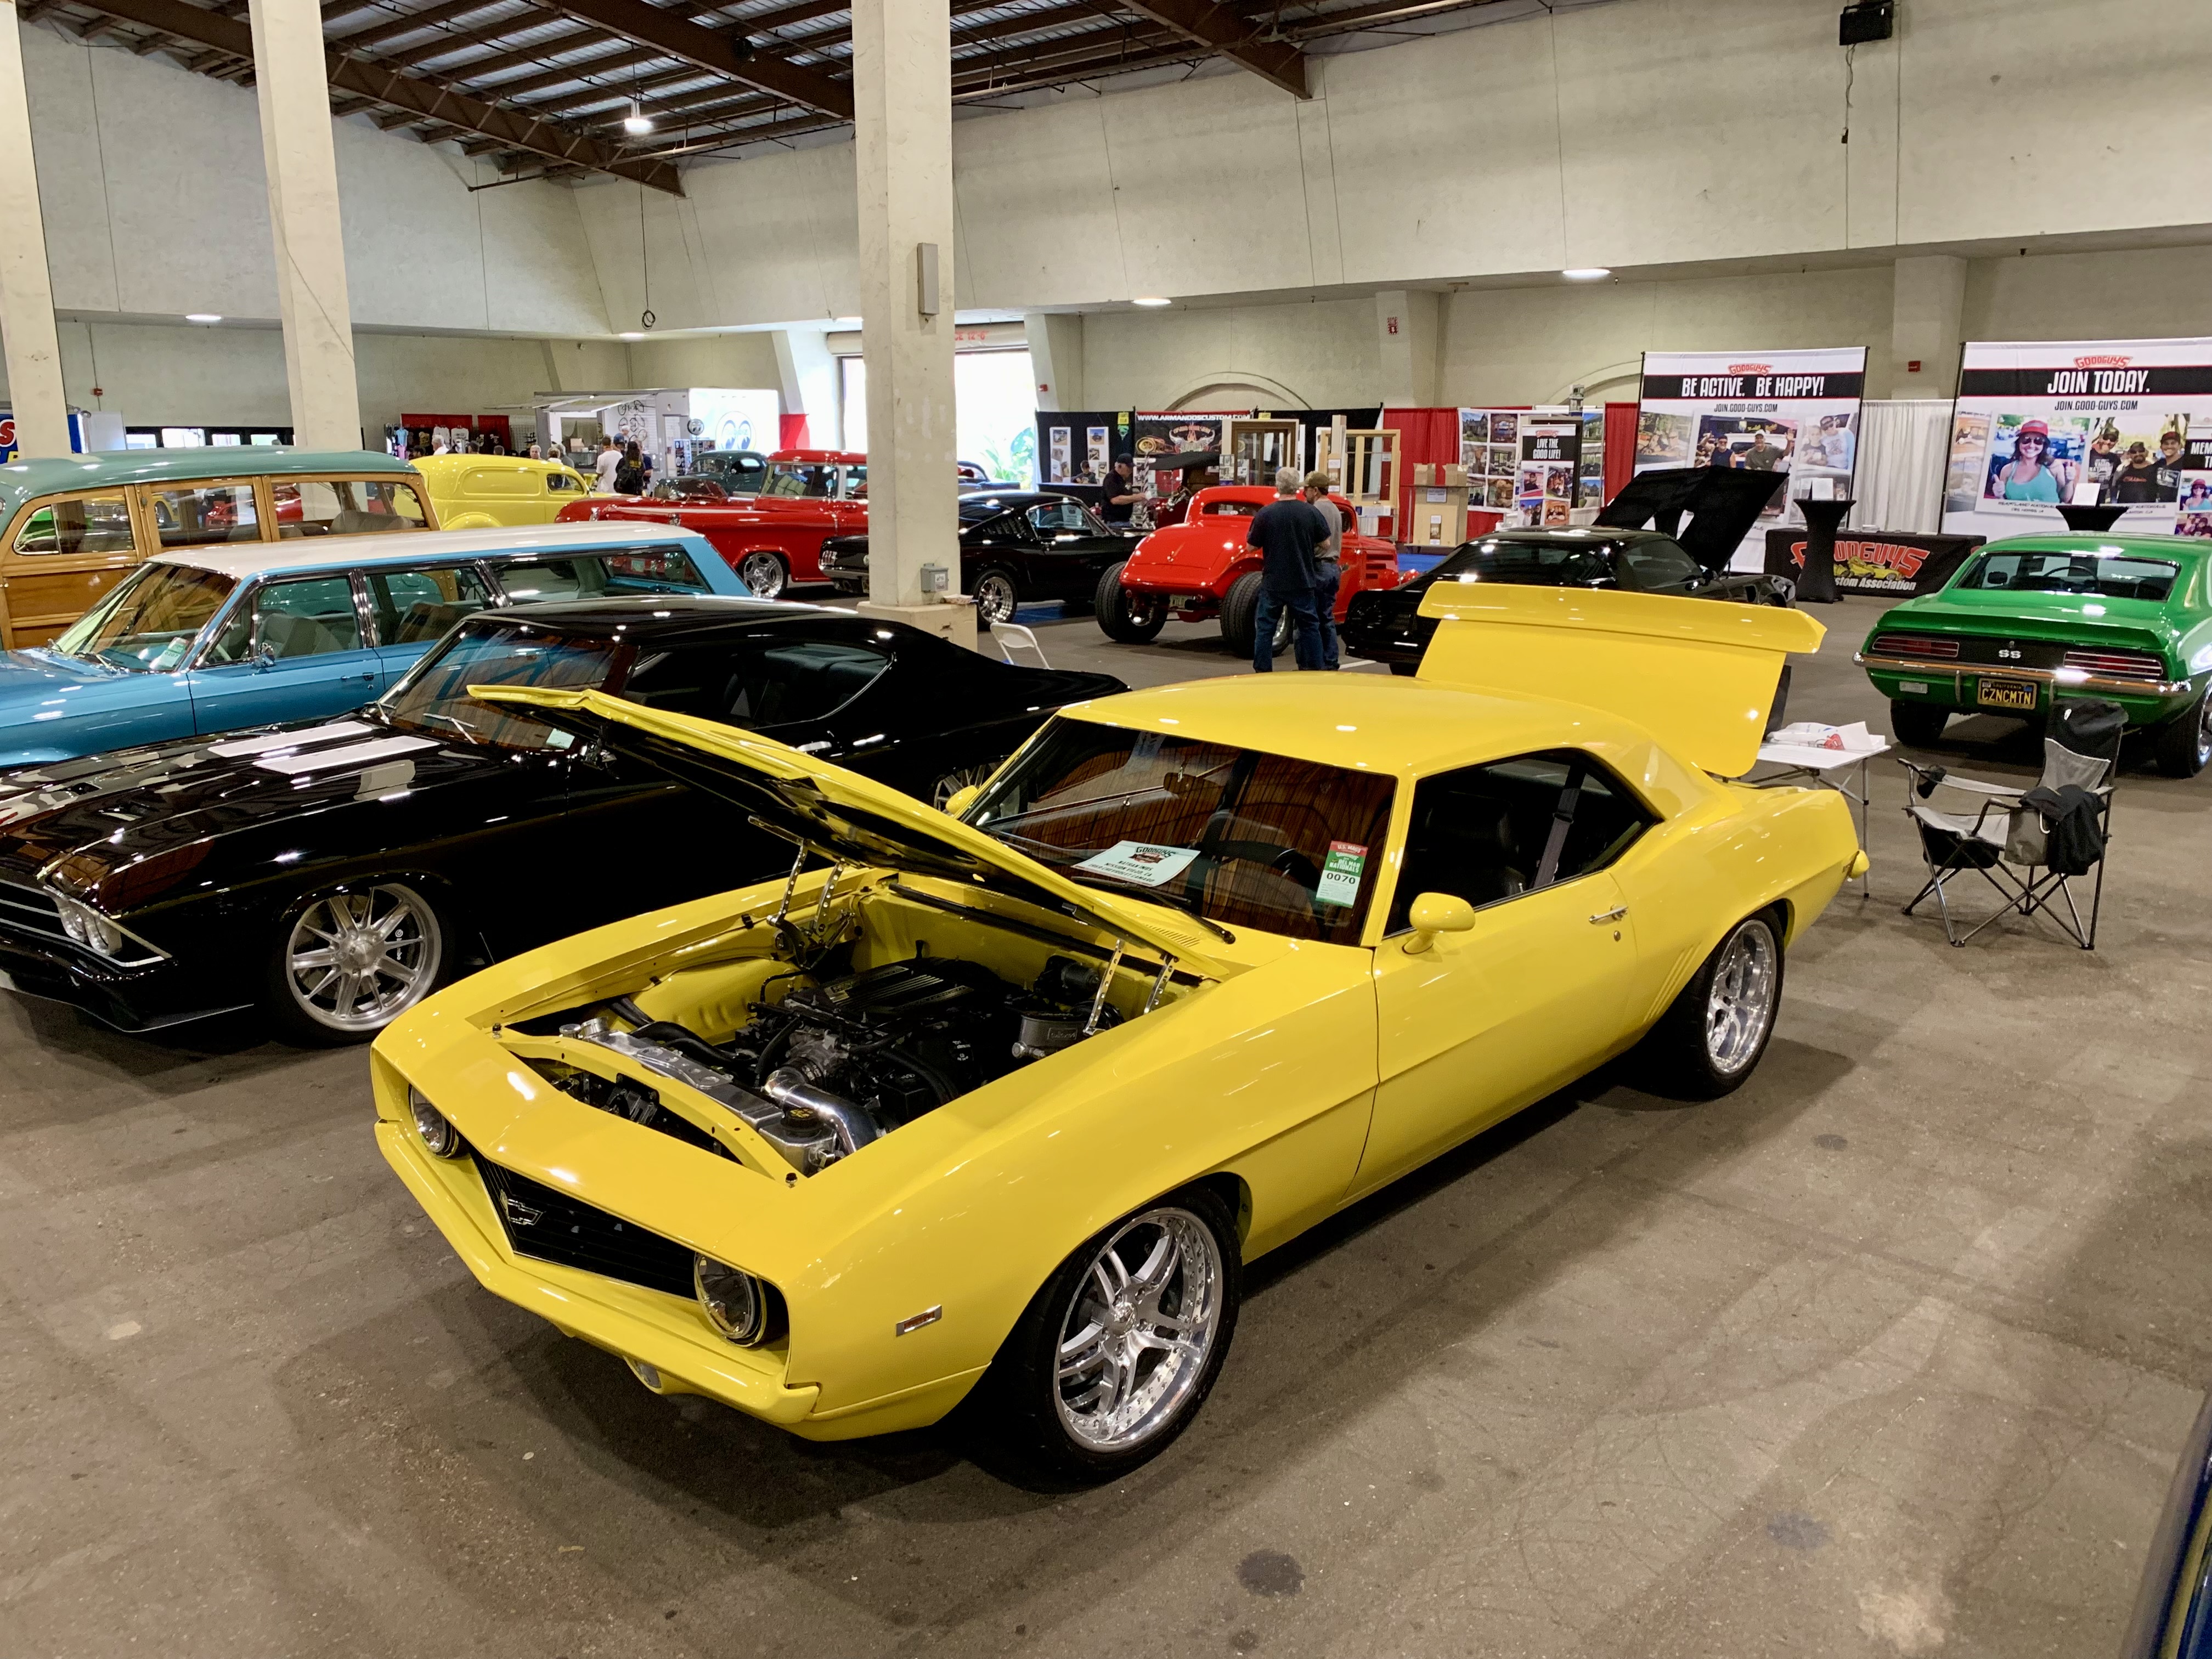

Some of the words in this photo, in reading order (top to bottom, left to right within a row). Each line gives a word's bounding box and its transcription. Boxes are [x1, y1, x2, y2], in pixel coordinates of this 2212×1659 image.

[2075, 356, 2131, 369] GOODGUYS
[1729, 363, 1773, 376] GOODGUYS
[1681, 377, 1697, 397] BE
[1700, 377, 1745, 397] ACTIVE.
[1756, 377, 1773, 397] BE
[1775, 376, 1825, 397] HAPPY!
[2047, 371, 2089, 394] JOIN
[2094, 370, 2150, 393] TODAY.
[1714, 403, 1778, 413] JOIN.GOOD-GUYS.COM
[2055, 400, 2138, 411] JOIN.GOOD-GUYS.COM
[1537, 438, 1548, 448] LIVE
[1548, 438, 1559, 448] THE
[1533, 449, 1548, 459] GOOD
[1548, 449, 1561, 459] LIFE!
[1835, 576, 1858, 588] stom
[1859, 577, 1917, 591] Association
[1999, 650, 2021, 658] SS
[1982, 687, 2032, 705] CZNCMTN
[1135, 847, 1176, 858] GOODGUYS
[1347, 845, 1362, 854] MAGS
[1327, 872, 1356, 884] 0070
